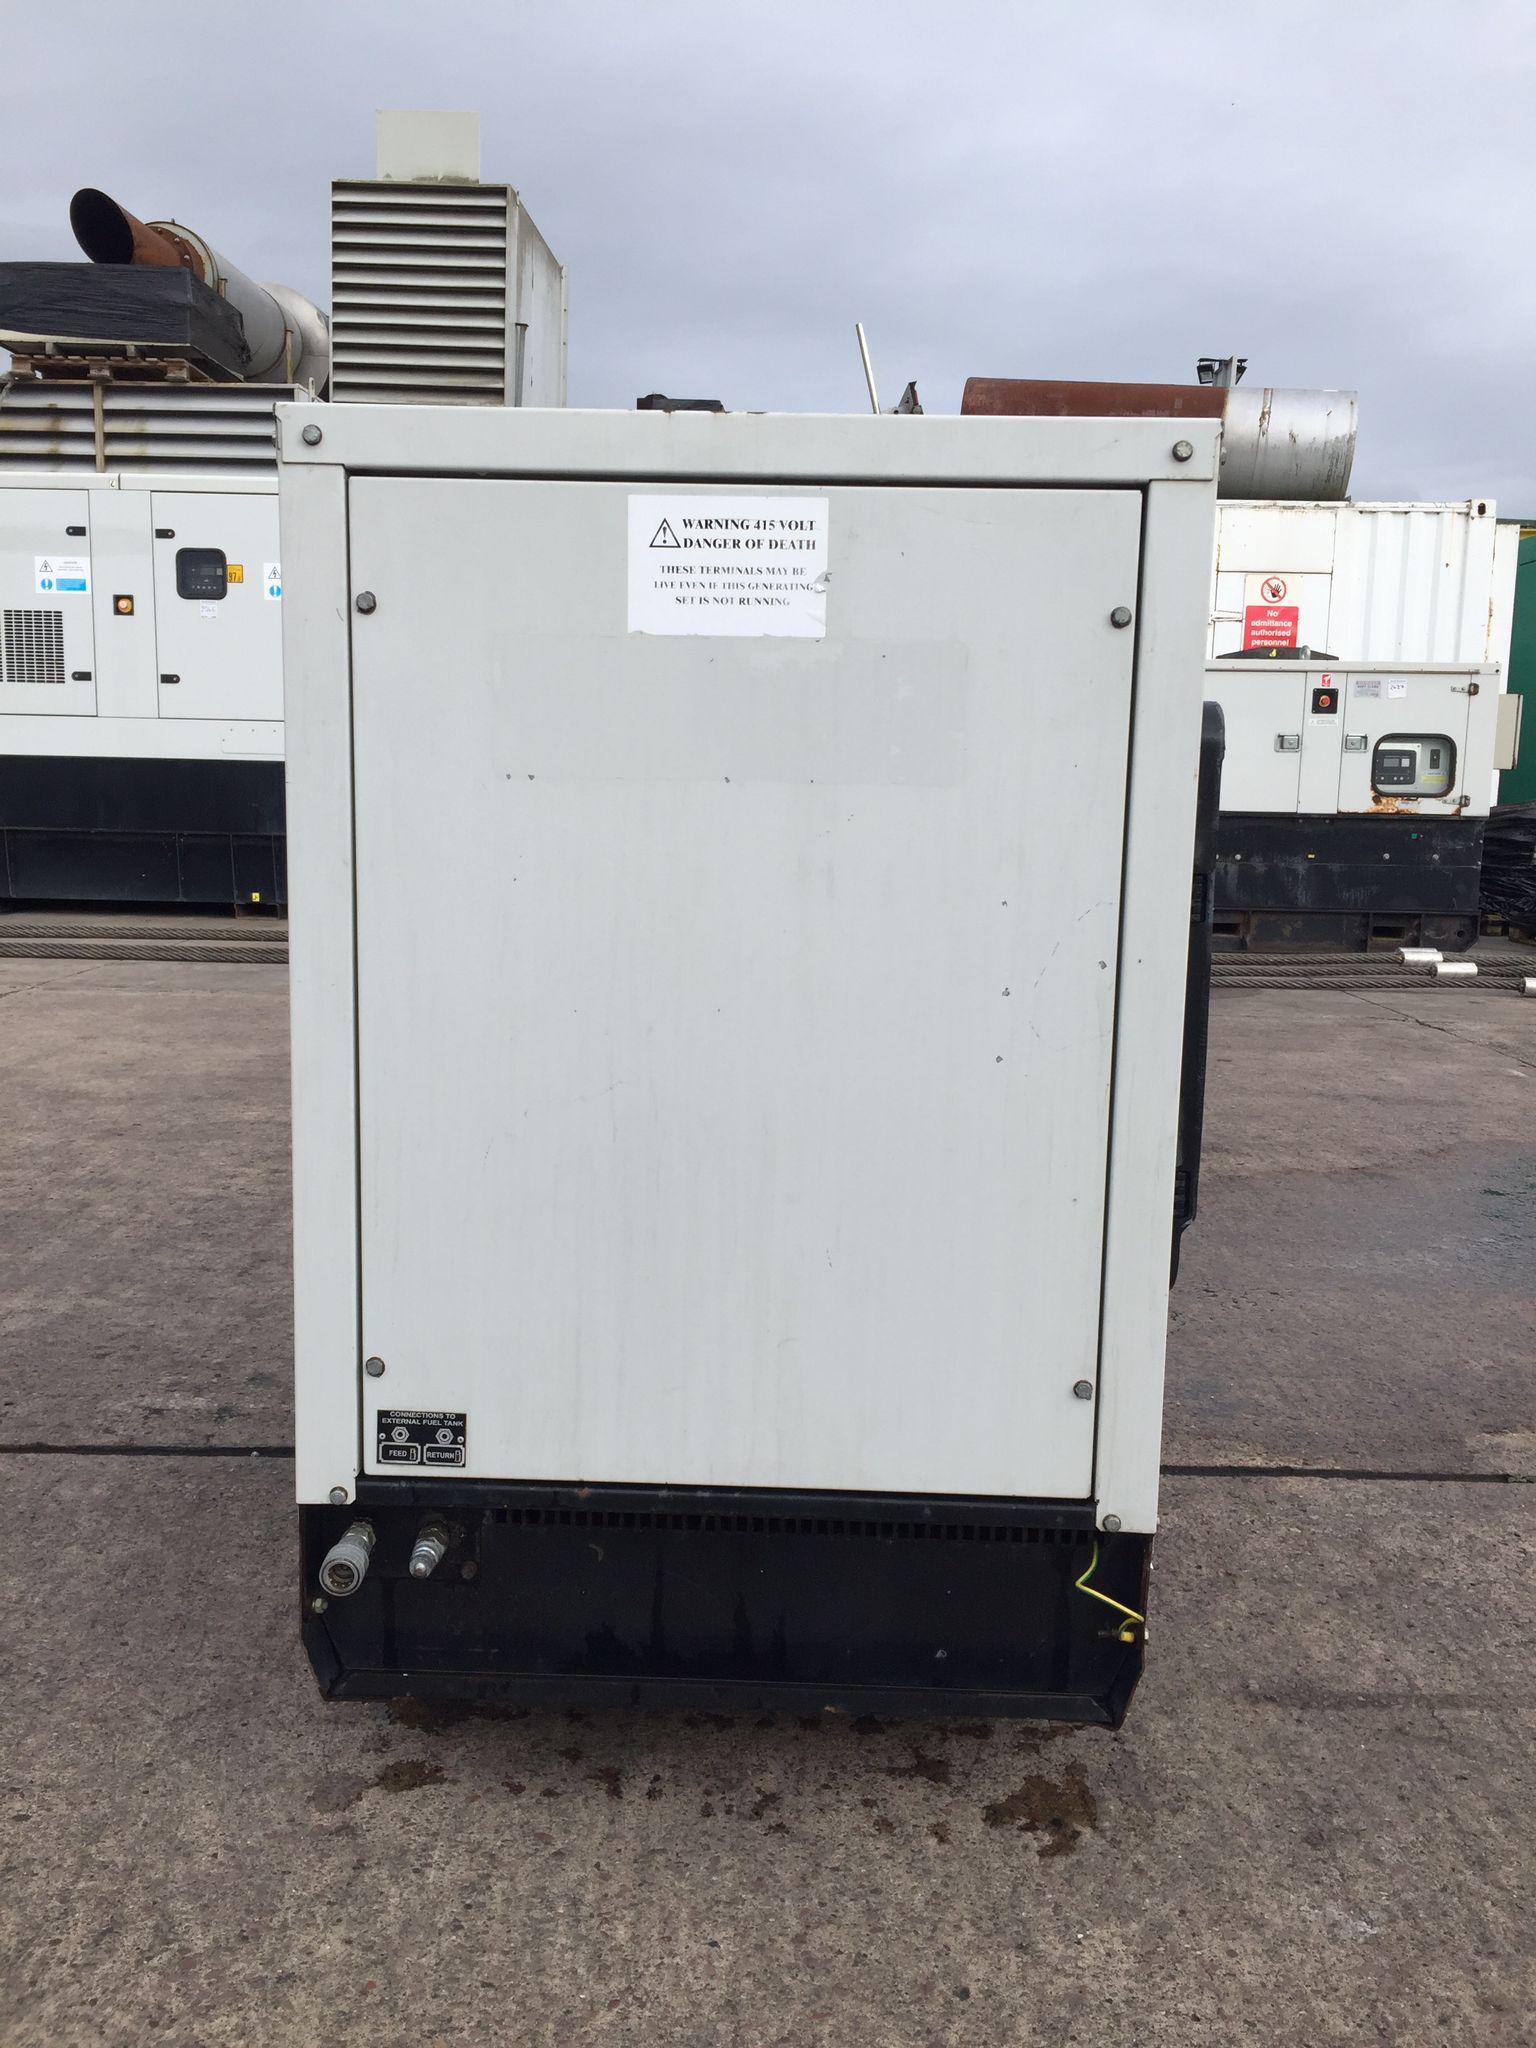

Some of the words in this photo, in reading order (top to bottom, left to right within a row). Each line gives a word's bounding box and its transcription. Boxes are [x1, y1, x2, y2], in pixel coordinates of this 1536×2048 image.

[682, 518, 750, 530] WARNING
[753, 519, 776, 531] 415
[779, 520, 817, 531] VOLT
[683, 538, 741, 549] DANGER
[745, 539, 764, 549] OF
[768, 539, 816, 550] DEATH
[660, 565, 696, 574] THESE
[700, 566, 763, 576] TERMINALS
[765, 567, 789, 576] MAY
[792, 567, 807, 576] BE
[654, 581, 677, 589] LIVE
[679, 581, 705, 589] EVEN
[708, 582, 720, 590] IF
[722, 582, 745, 590] THIS
[747, 582, 814, 591] GENERATING
[675, 596, 695, 605] SET
[698, 596, 710, 605] IS
[713, 597, 735, 606] NOT
[738, 597, 791, 607] RUNNING
[1251, 639, 1290, 647] personnel
